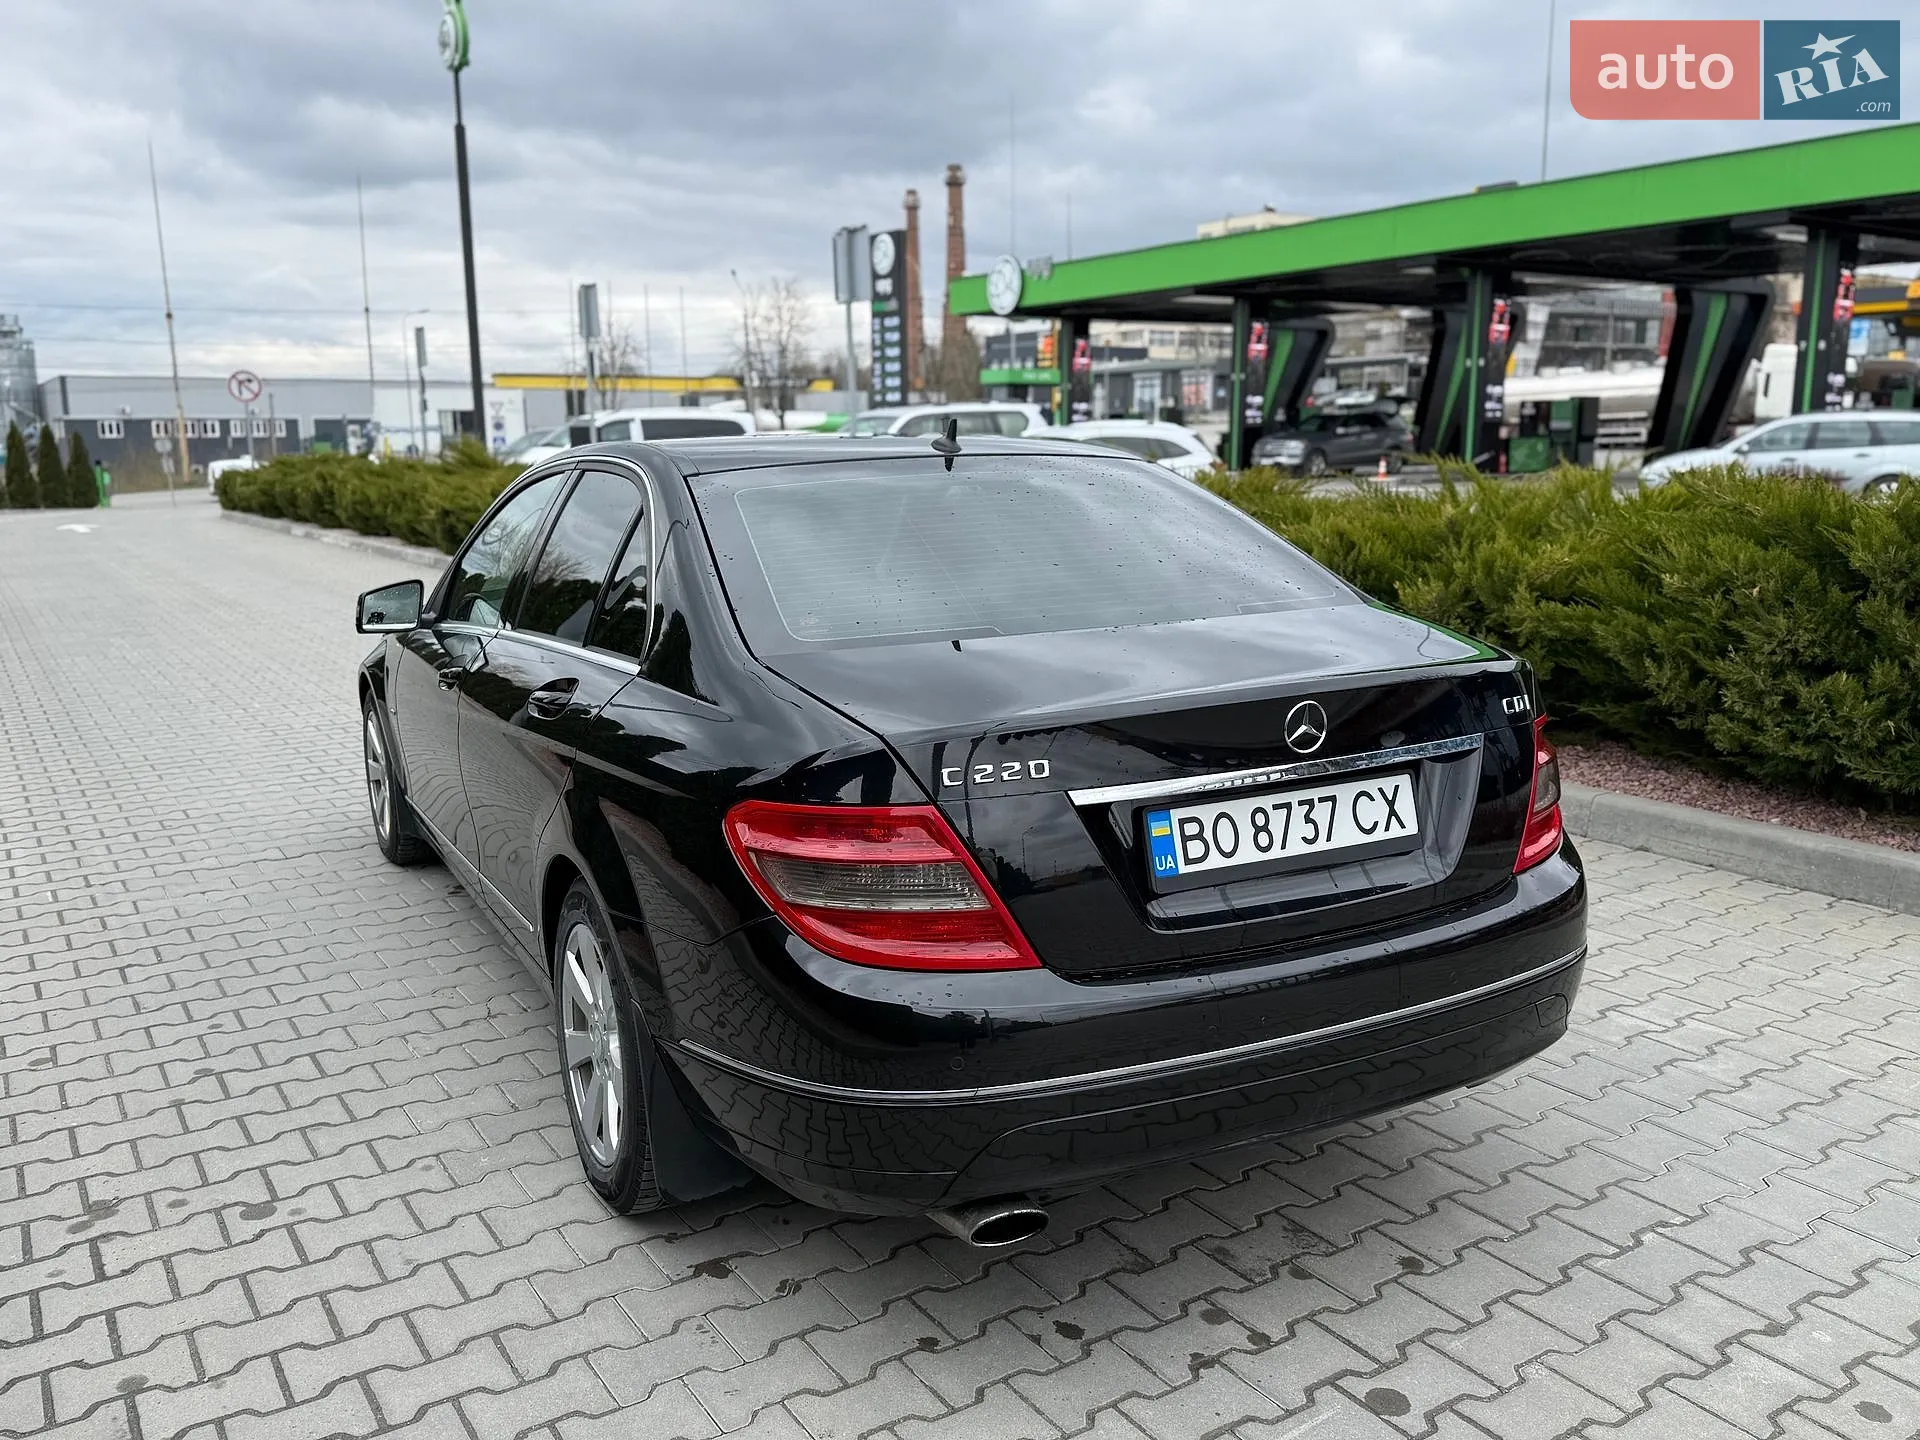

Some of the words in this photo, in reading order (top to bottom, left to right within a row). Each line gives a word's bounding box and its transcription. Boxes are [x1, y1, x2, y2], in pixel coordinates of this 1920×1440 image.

[1502, 694, 1530, 714] CDI
[940, 767, 964, 786] C
[972, 759, 1051, 785] 220
[1177, 811, 1240, 867] BO
[1250, 794, 1338, 853] 8737
[1351, 784, 1407, 836] CX
[1155, 853, 1176, 871] UA
